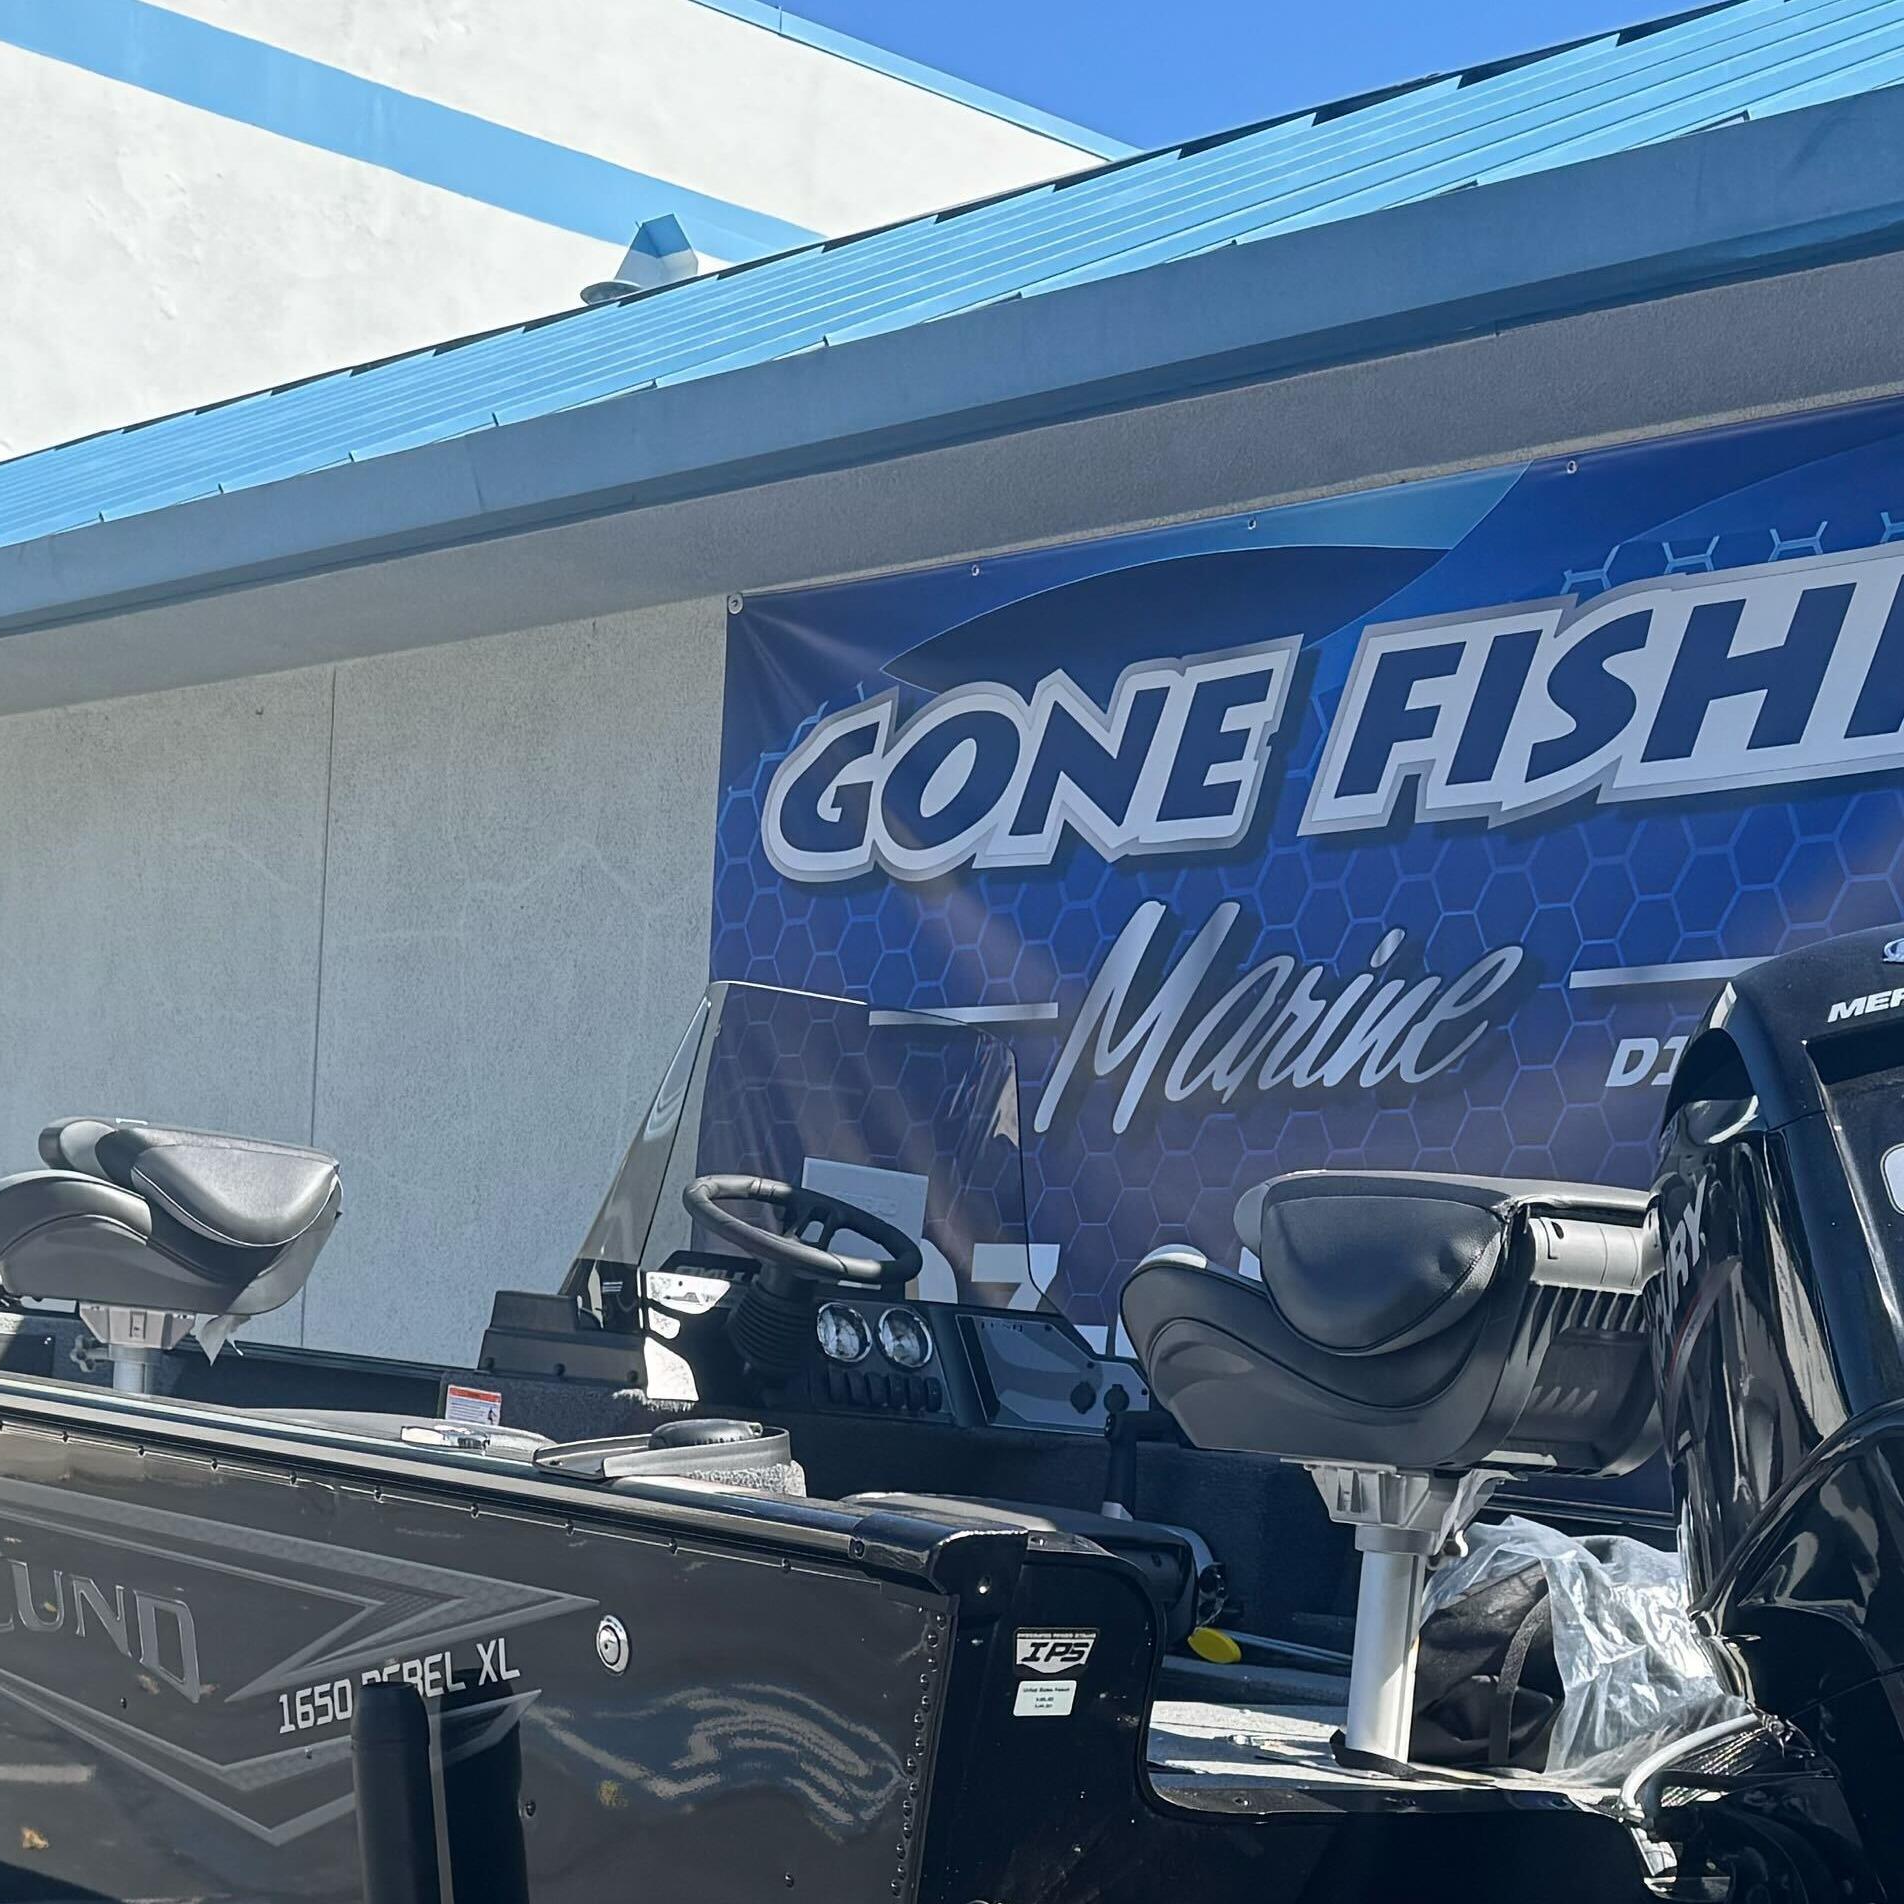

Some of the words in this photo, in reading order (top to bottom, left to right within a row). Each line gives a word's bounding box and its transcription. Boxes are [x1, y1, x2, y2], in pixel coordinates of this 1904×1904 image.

[766, 645, 1292, 872] GONE
[1032, 900, 1523, 1135] Marine
[279, 1678, 354, 1734] 1650
[476, 1637, 521, 1686] XL
[1021, 1641, 1090, 1662] IPS
